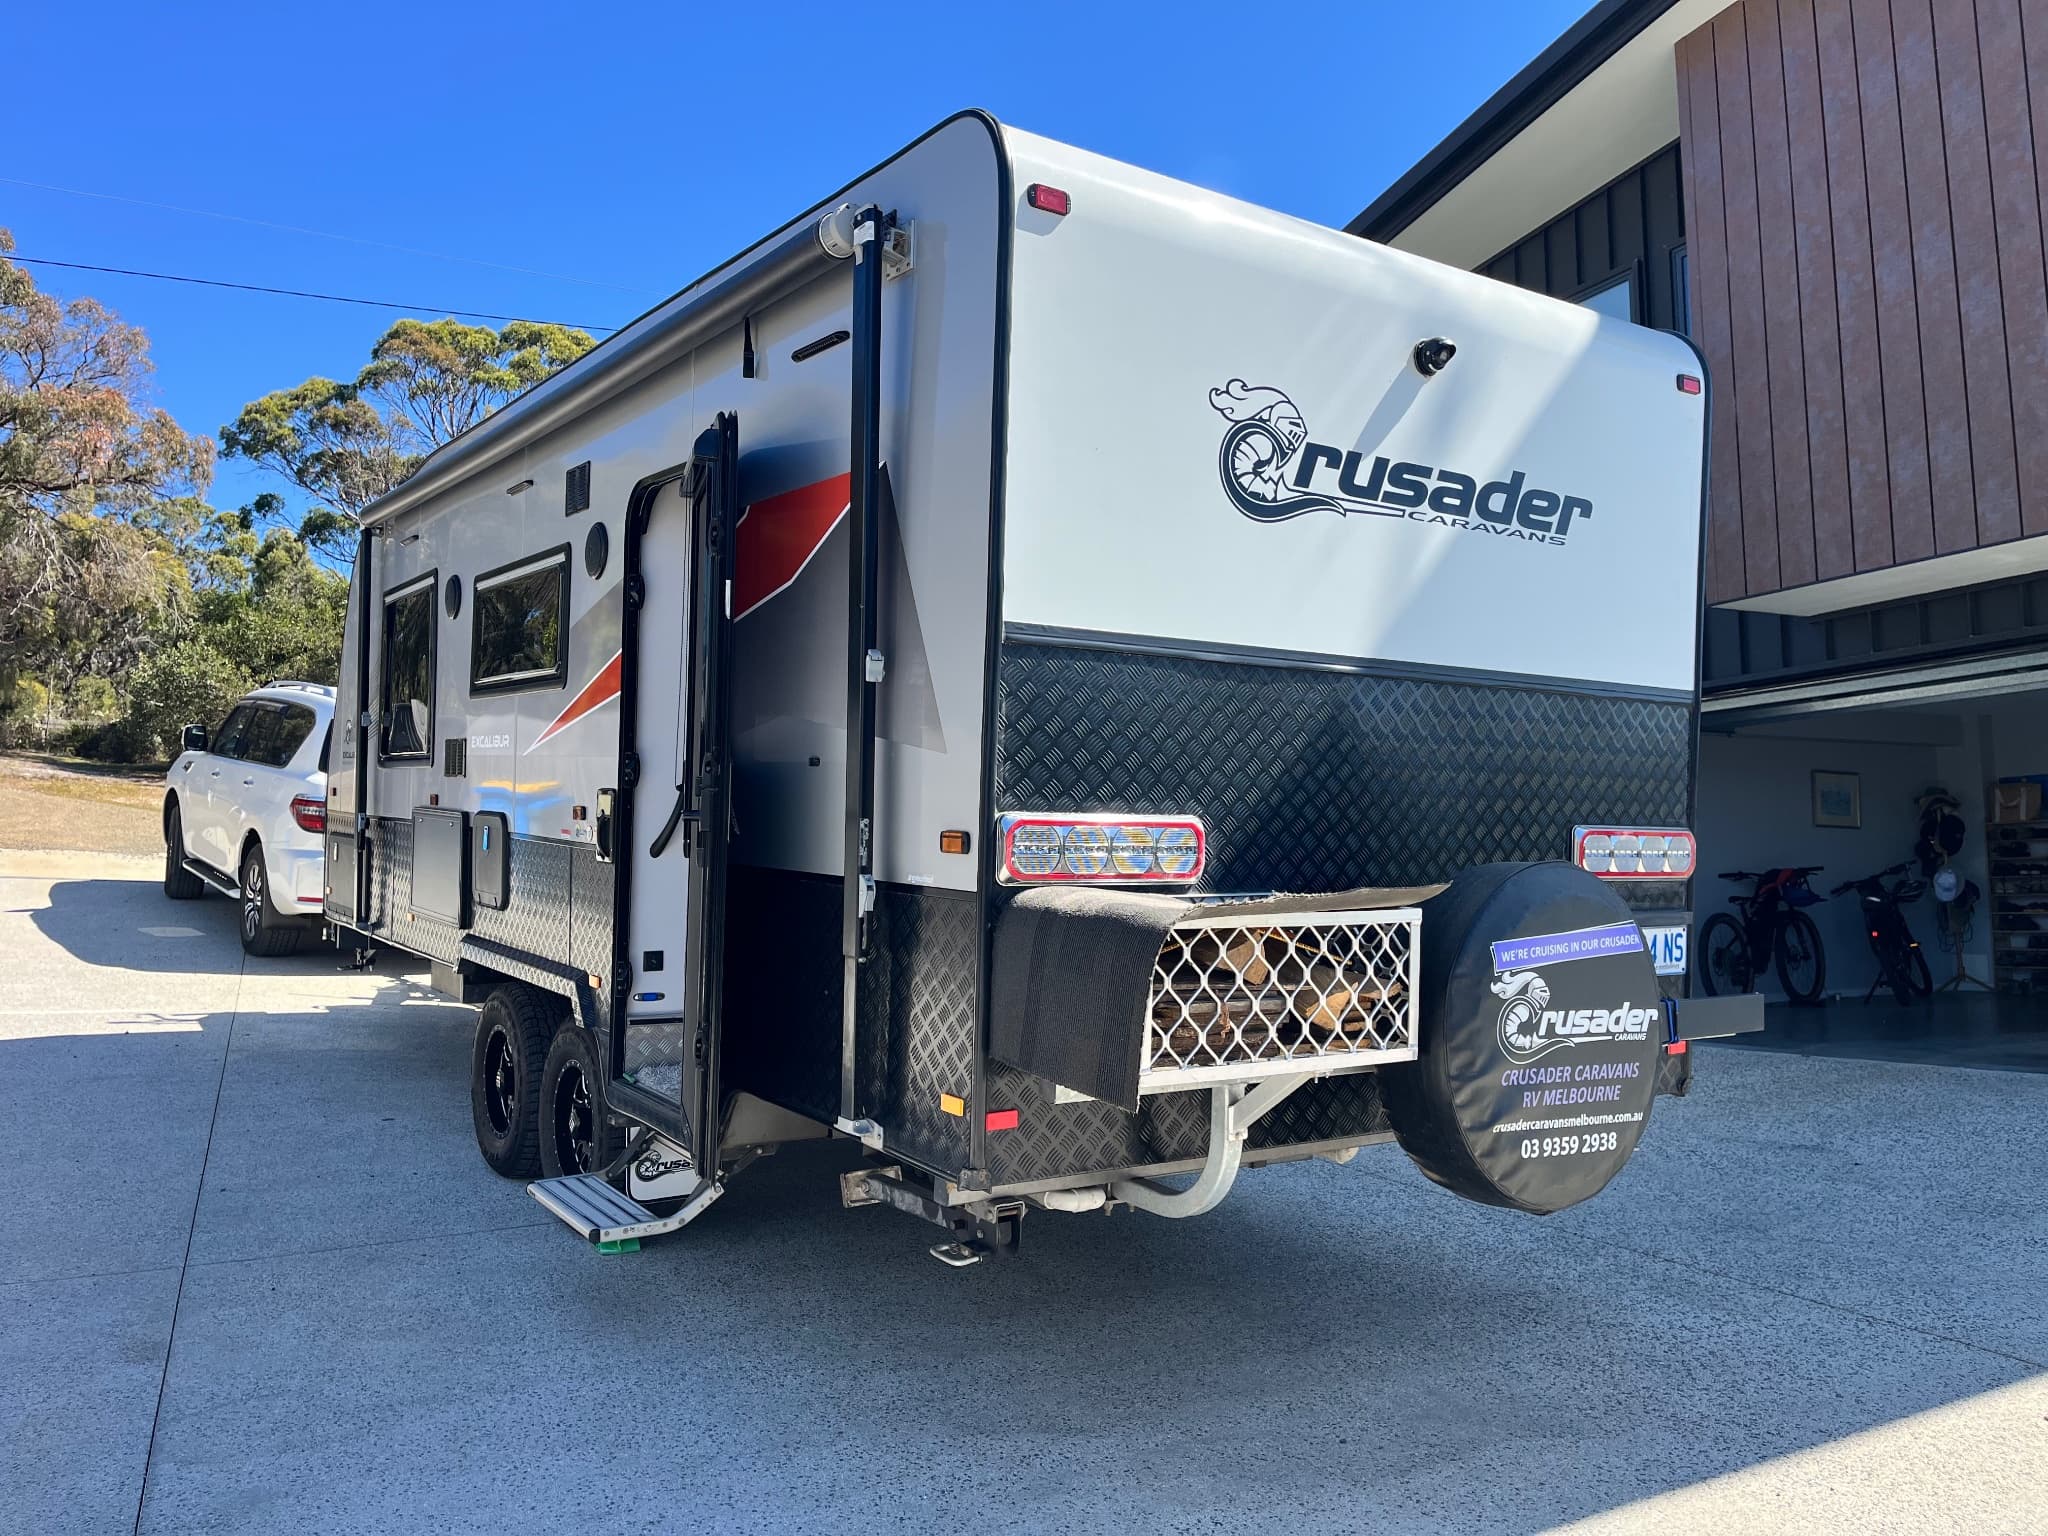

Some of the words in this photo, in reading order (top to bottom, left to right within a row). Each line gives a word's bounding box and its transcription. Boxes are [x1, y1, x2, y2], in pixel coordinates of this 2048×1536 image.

[1407, 511, 1567, 547] CARAVANS
[471, 734, 510, 749] EXCALIBUR
[1501, 949, 1529, 963] WE'RE
[1530, 943, 1569, 958] CRUISING
[1570, 942, 1580, 952] IN
[1581, 938, 1599, 950] OUR
[1600, 934, 1640, 948] CRUSADER
[1663, 932, 1684, 963] NS
[1614, 1033, 1647, 1042] CARAVANS
[1501, 1065, 1572, 1087] CRUSADER
[1574, 1062, 1640, 1082] CARAVANS
[1522, 1090, 1541, 1108] RV
[1543, 1085, 1621, 1106] MELBOURNE
[1492, 1111, 1643, 1133] crusadercaravansmelbourne.com.au
[1521, 1138, 1540, 1159] 03
[1543, 1135, 1579, 1158] 9359
[1581, 1132, 1617, 1153] 2938
